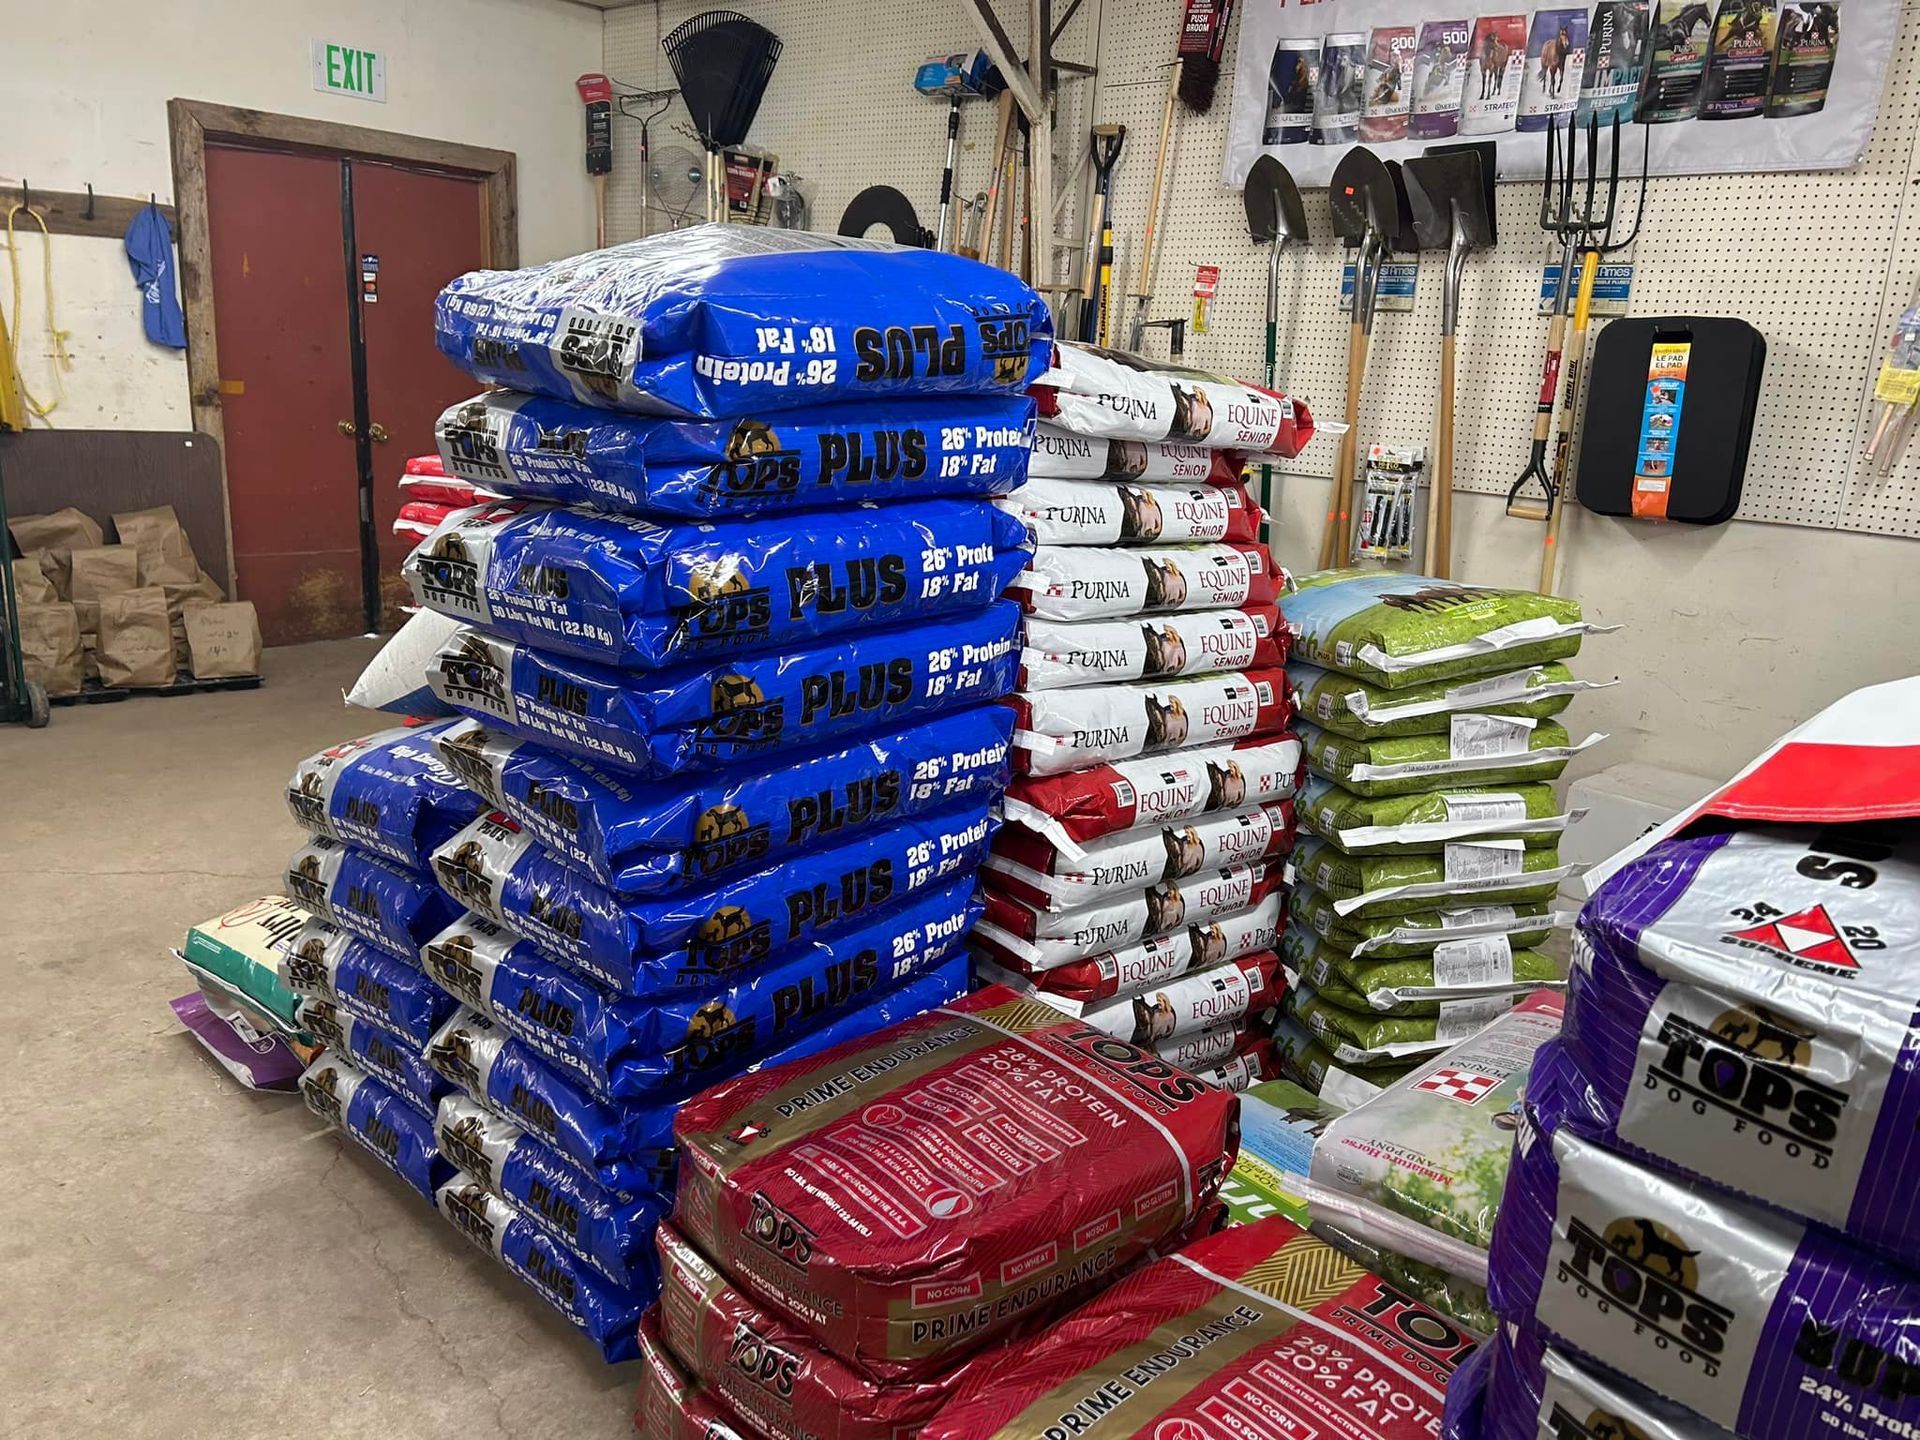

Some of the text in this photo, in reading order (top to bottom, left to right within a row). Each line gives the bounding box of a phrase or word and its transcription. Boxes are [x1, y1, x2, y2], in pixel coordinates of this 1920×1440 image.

[1186, 24, 1209, 32] BROOM
[1191, 14, 1208, 22] PUSH
[1599, 11, 1614, 55] PURINA
[1391, 37, 1415, 50] 200
[1442, 32, 1468, 45] 500
[1733, 39, 1761, 48] PURINA
[1800, 39, 1826, 47] PURINA
[326, 44, 376, 95] EXIT
[1594, 66, 1643, 88] IMPACT
[1390, 267, 1415, 275] Ames
[1600, 268, 1630, 276] Ames
[541, 314, 557, 328] 50
[757, 327, 836, 353] 18% Fat
[855, 324, 965, 382] PLUS
[695, 355, 837, 387] 26% Protein
[1227, 404, 1278, 428] EQUINE
[941, 427, 972, 450] 26%
[1033, 435, 1092, 460] PURINA
[1235, 429, 1273, 445] SENIOR
[816, 428, 927, 486] PLUS
[939, 453, 997, 478] 18% Fat
[1172, 463, 1207, 477] SENIOR
[1045, 501, 1226, 525] PURINA EQUINE
[1188, 524, 1224, 537] SENIOR
[921, 545, 953, 572] 26%
[416, 559, 478, 596] TOPS
[785, 554, 908, 621] PLUS
[920, 571, 979, 599] 18% Fat
[1070, 567, 1246, 602] PURINA EQUINE
[551, 601, 568, 616] Fat
[1210, 590, 1244, 603] SENIOR
[492, 605, 596, 640] 50 (22.68
[928, 638, 1012, 674] 26% Protein
[1066, 630, 1252, 671] PURINA EQUINE
[1212, 654, 1250, 668] SENIOR
[440, 660, 589, 717] TOPS PLUS
[800, 658, 913, 726] PLUS
[926, 669, 982, 698] 18% Fat
[518, 710, 530, 725] 50
[1071, 700, 1254, 748] PURINA EQUINE
[1214, 723, 1250, 738] SENIOR
[913, 756, 947, 780] 26%
[909, 774, 974, 800] 18% Fat
[1139, 784, 1194, 813] EQUINE
[787, 769, 901, 845] PLUS
[477, 821, 509, 842] PLUS
[907, 841, 936, 869] 26%
[1091, 824, 1268, 886] PURINA EQUINE
[1226, 847, 1263, 864] SENIOR
[908, 854, 963, 891] 18% Fat
[785, 858, 894, 939] PLUS
[1200, 879, 1249, 908] EQUINE
[1210, 900, 1248, 917] SENIOR
[892, 930, 922, 958] 26%
[1718, 934, 1863, 981] SUPREME
[892, 954, 920, 979] 18%
[1122, 951, 1175, 983] EQUINE
[772, 949, 880, 1032] PLUS
[1192, 989, 1246, 1019] EQUINE
[517, 986, 575, 1037] PLUS
[1205, 1011, 1241, 1026] SENIOR
[1178, 1030, 1231, 1062] EQUINE
[775, 1023, 983, 1120] PRIME ENDURANCE
[979, 1053, 1070, 1105] 20% FAT
[1057, 1030, 1206, 1104] TOPS
[1449, 1060, 1511, 1079] PURINA
[953, 1089, 980, 1106] CORN
[999, 1046, 1128, 1129] 28% PROTEIN
[1086, 1060, 1168, 1116] DOG FOOD
[1656, 1022, 1843, 1143] TOPS
[1001, 1122, 1046, 1154] NO WHEAT
[1643, 1075, 1830, 1171] DOG FOOD
[974, 1131, 1023, 1170] NO GLUTEN
[1341, 1139, 1382, 1159] Horse
[1367, 1138, 1436, 1169] AND PONY
[1382, 1152, 1454, 1185] Miniature
[843, 1172, 873, 1200] SOURCED
[528, 1179, 579, 1235] PLUS
[745, 1194, 813, 1265] TOPS
[1096, 1221, 1110, 1235] SOY
[525, 1249, 576, 1301] PLUS
[1010, 1253, 1050, 1275] NO WHEAT
[912, 1247, 1117, 1344] PRIME ENDURANCE
[926, 1289, 942, 1301] NO
[1566, 1223, 1731, 1355] TOPS
[1556, 1269, 1719, 1379] DOG FOOD
[731, 1320, 798, 1397] TOPS
[1292, 1336, 1353, 1370] 28%
[1331, 1310, 1450, 1384] PRIME DOG
[1042, 1304, 1264, 1440] PRIME ENDURANCE
[1263, 1368, 1316, 1406] FORMULATED
[1274, 1347, 1402, 1427] 20% FAT
[1799, 1375, 1853, 1413] 24%
[1222, 1411, 1245, 1430] NO
[1242, 1391, 1297, 1431] NO CORN
[1820, 1411, 1840, 1428] 50
